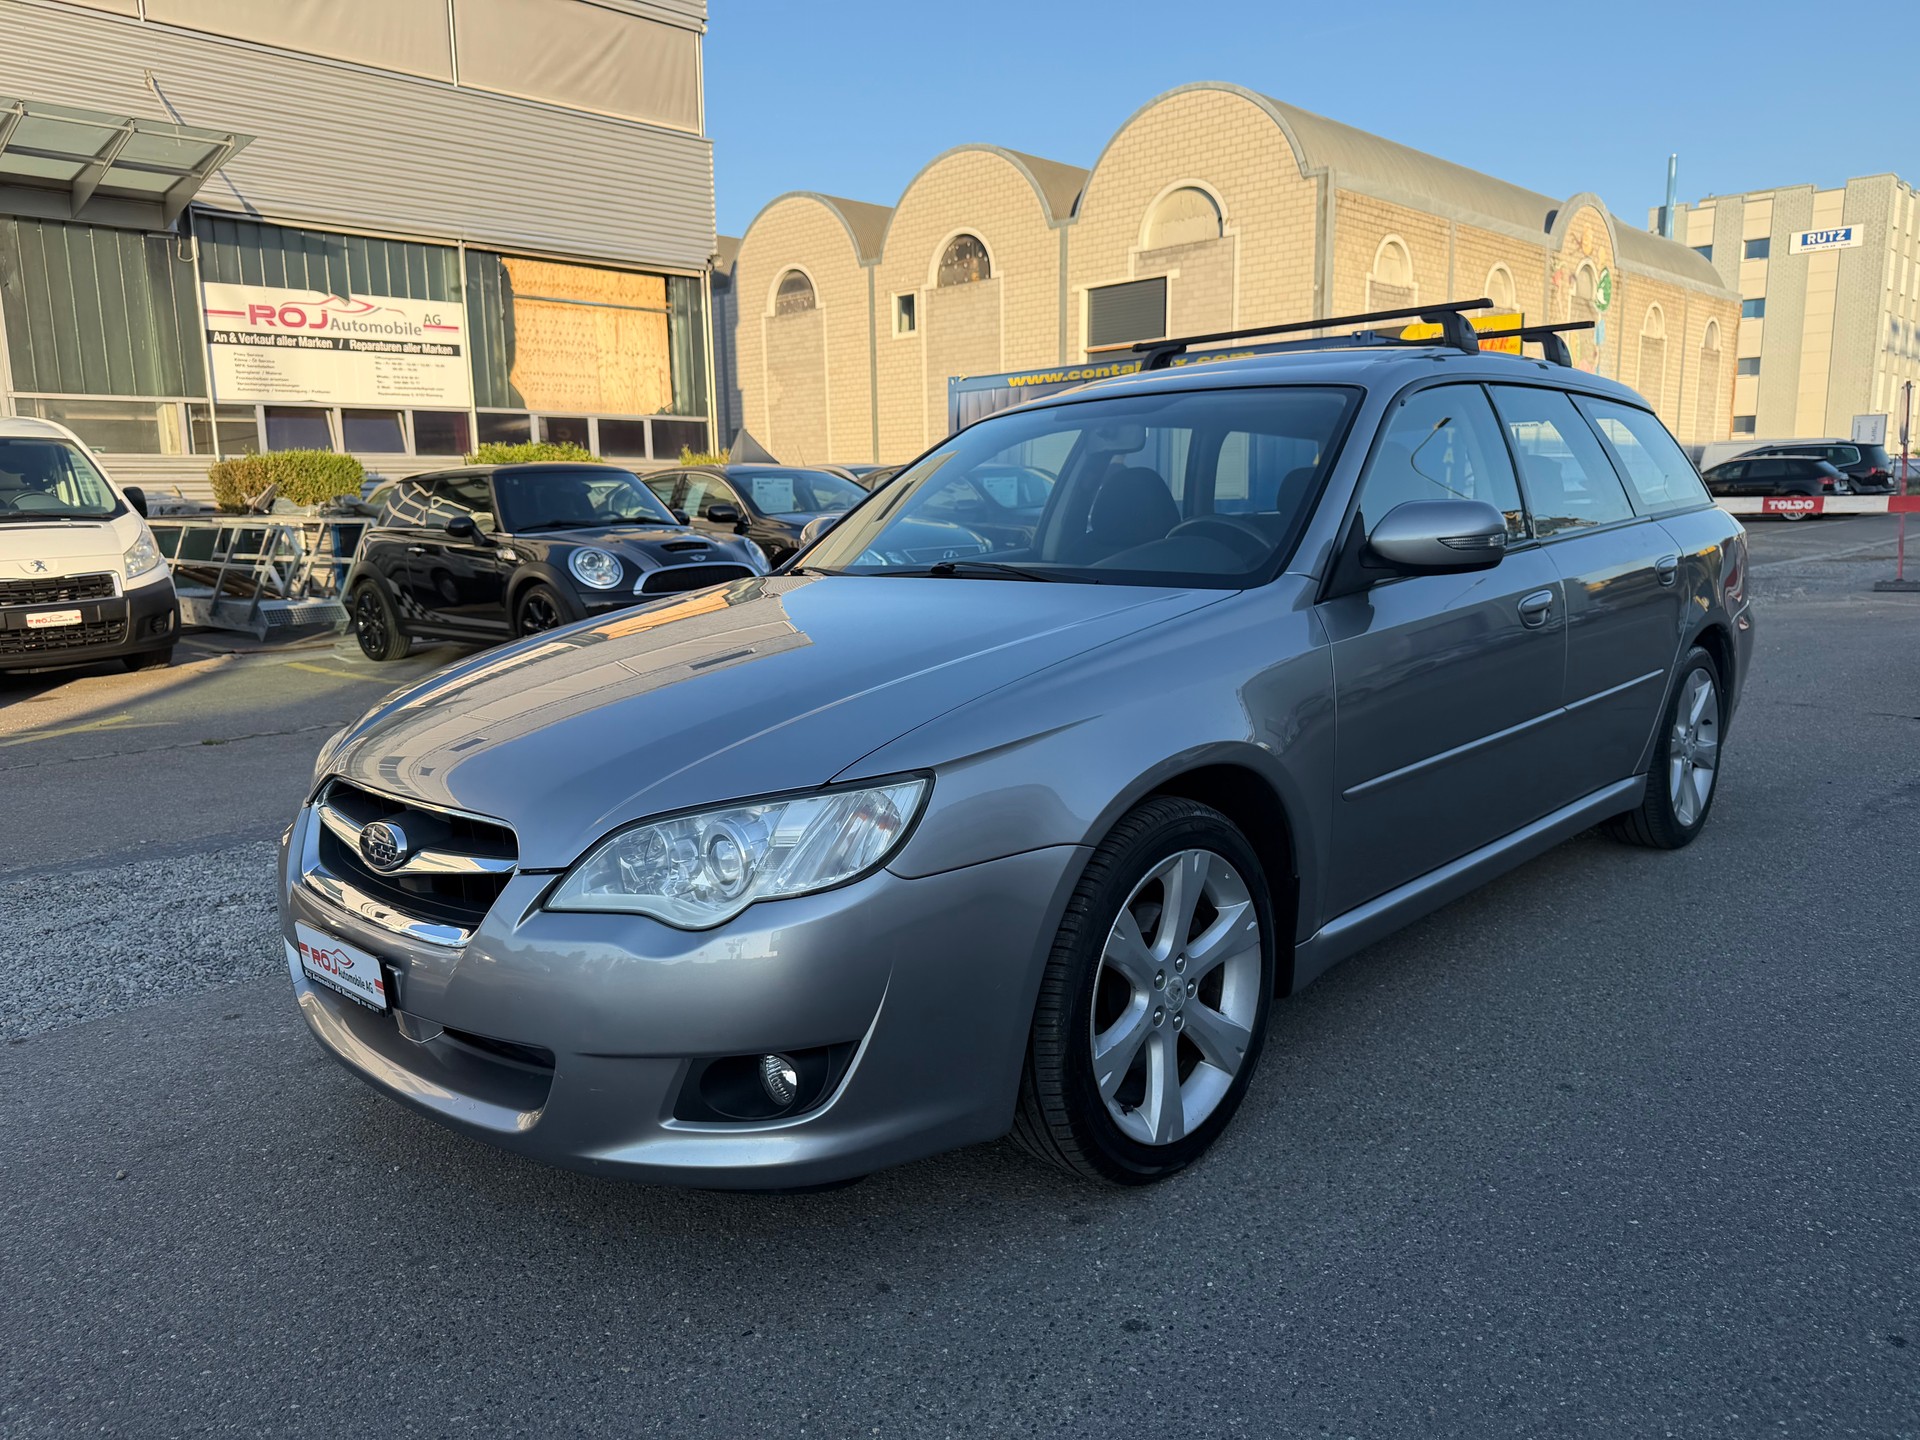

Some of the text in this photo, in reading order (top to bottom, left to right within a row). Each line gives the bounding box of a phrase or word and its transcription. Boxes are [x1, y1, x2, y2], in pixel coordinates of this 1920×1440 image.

[1807, 229, 1846, 245] RUTZ
[248, 304, 441, 336] ROJ Automobile AG
[213, 331, 227, 343] An
[238, 332, 275, 346] Verkauf
[276, 335, 297, 347] aller
[298, 336, 333, 349] Marken
[349, 339, 402, 352] Reparaturen
[402, 342, 421, 354] aller
[422, 343, 453, 355] Marken
[1768, 500, 1815, 510] TOLDO
[311, 947, 374, 994] ROJ Automobile AG
